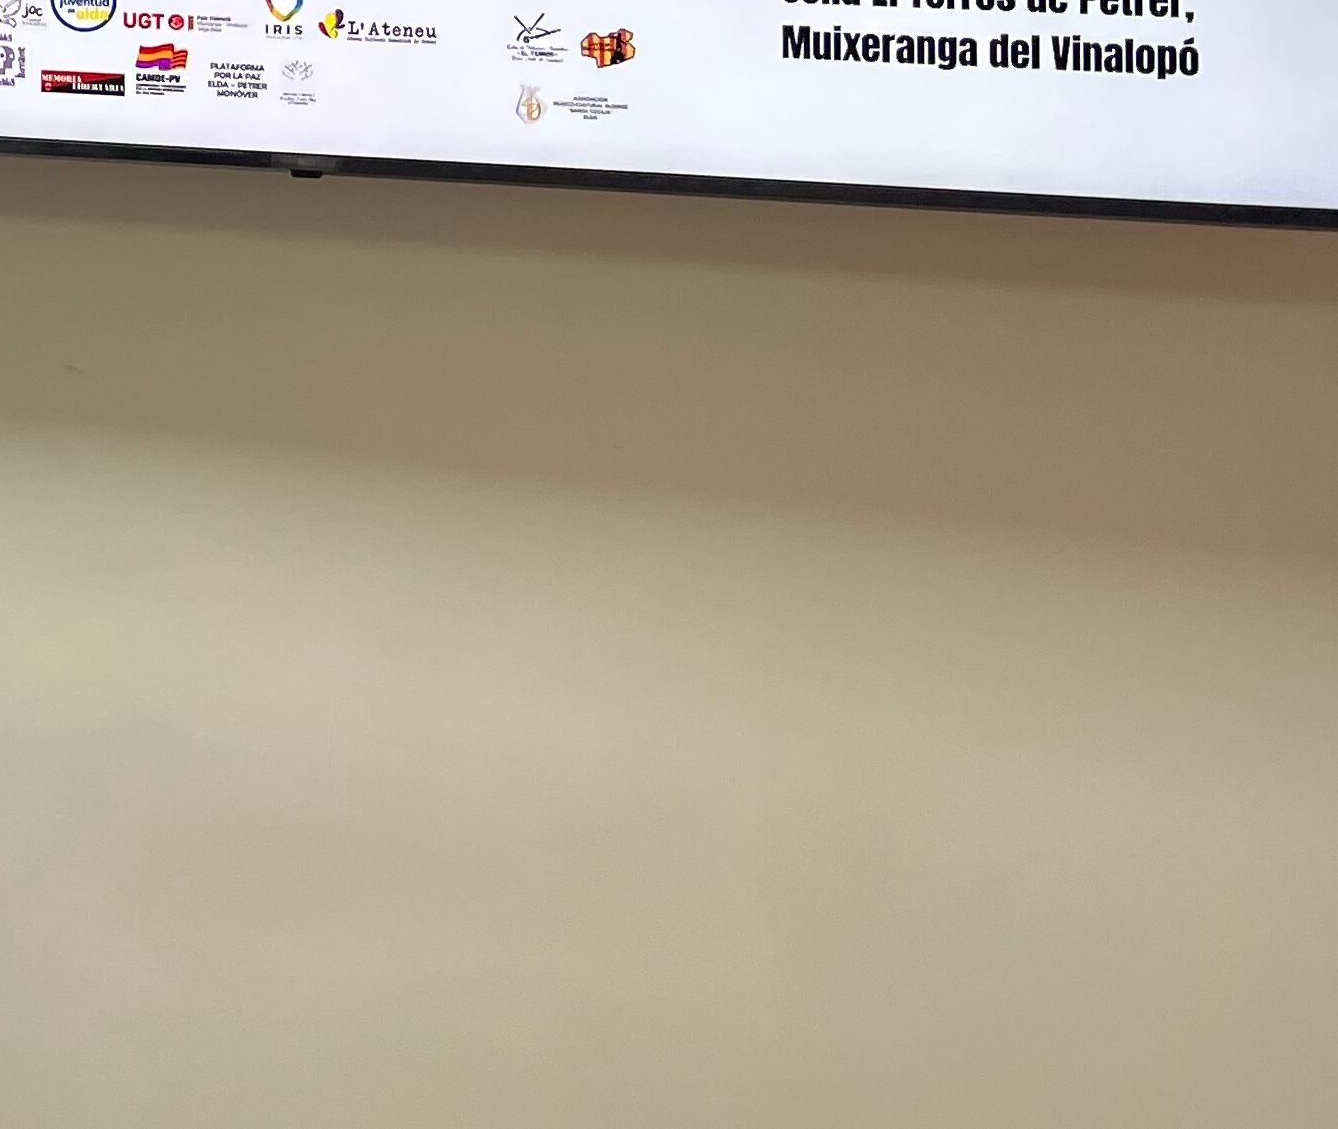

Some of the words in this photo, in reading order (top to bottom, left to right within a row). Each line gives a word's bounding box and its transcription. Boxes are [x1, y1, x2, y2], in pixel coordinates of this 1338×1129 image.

[123, 12, 165, 30] UGT
[265, 23, 304, 35] IRIS
[781, 25, 978, 70] Muixeranga
[989, 32, 1040, 70] del
[1052, 35, 1199, 79] Vinalopó
[210, 62, 265, 72] PLATAFORMA
[214, 71, 232, 80] POR
[232, 72, 243, 80] LA
[207, 80, 228, 89] ELDA
